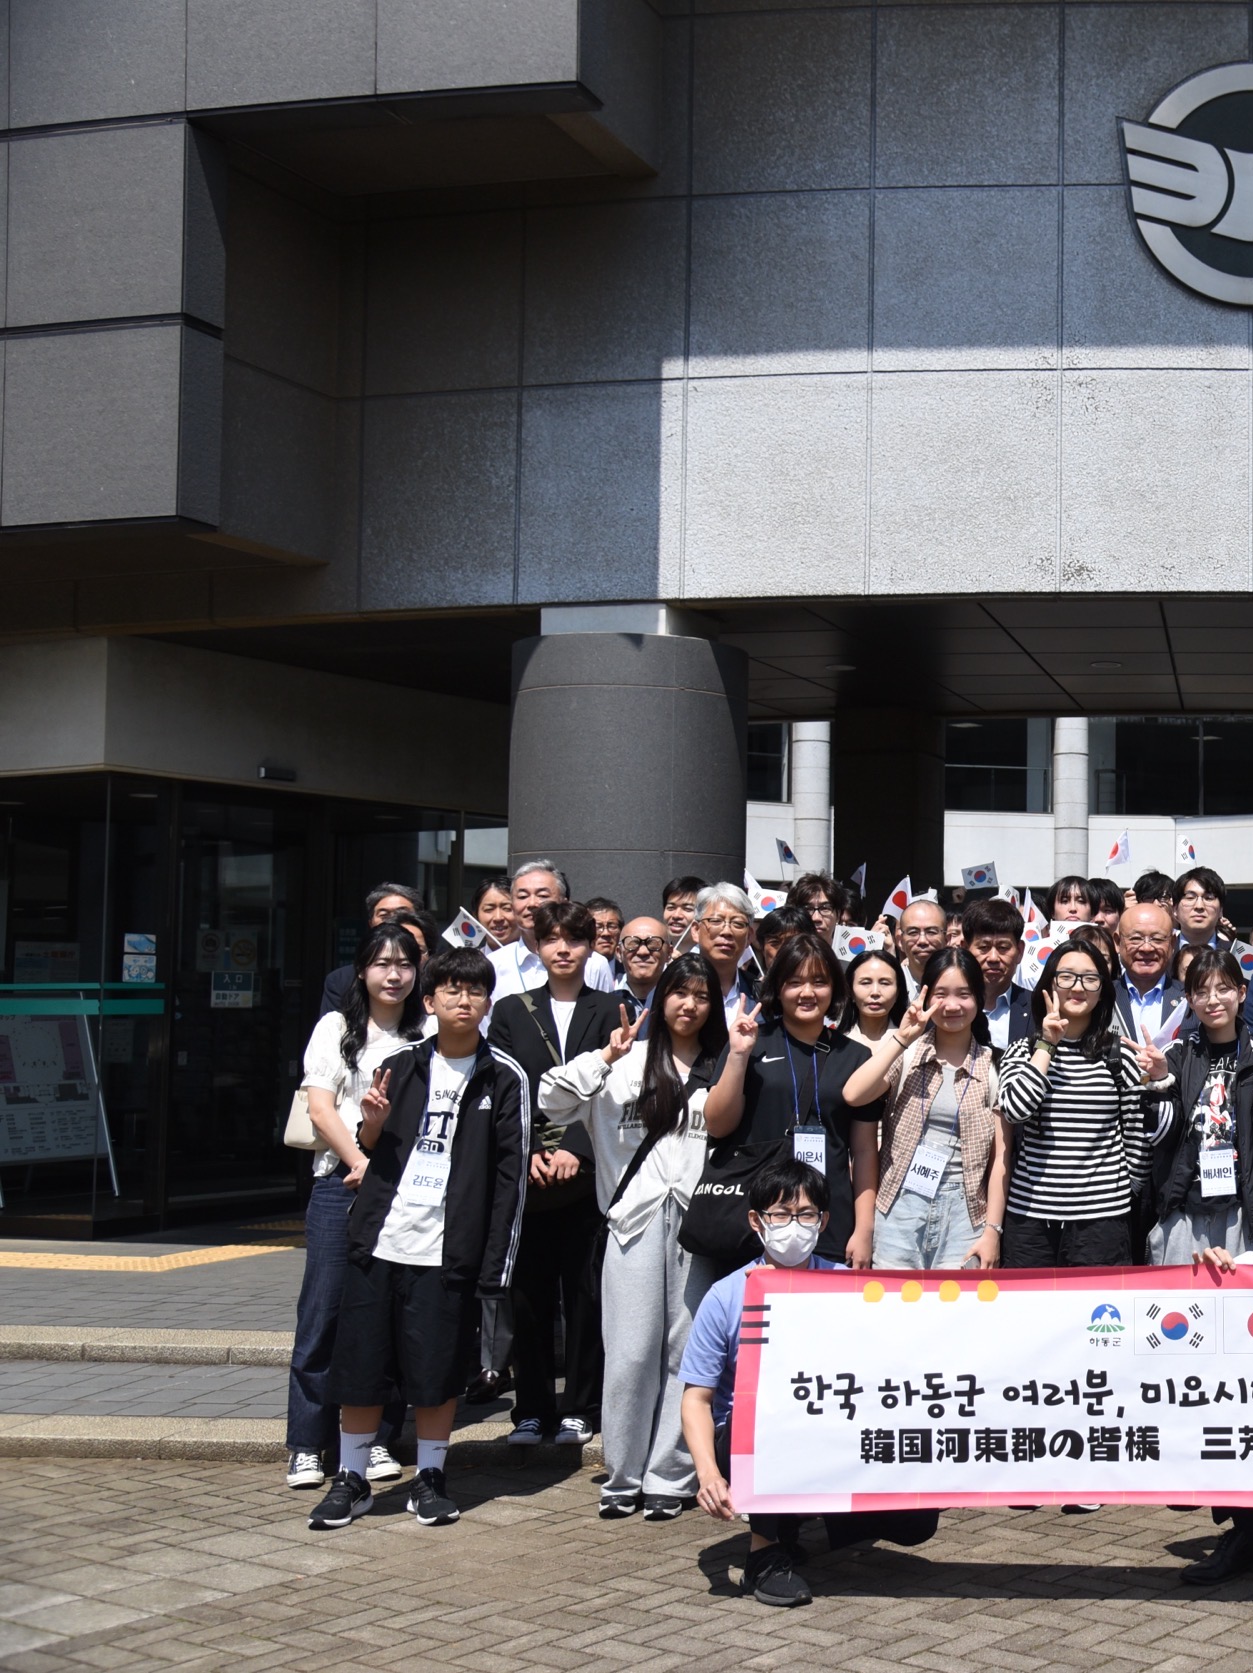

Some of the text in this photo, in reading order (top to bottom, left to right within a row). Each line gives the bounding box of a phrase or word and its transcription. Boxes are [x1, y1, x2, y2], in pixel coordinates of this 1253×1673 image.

[412, 1174, 444, 1190] 김도윤
[1089, 1337, 1121, 1347] 하동군
[790, 1371, 864, 1421] 한국
[877, 1372, 985, 1419] 하동군
[1002, 1369, 1125, 1419] 여러분,
[860, 1425, 1160, 1464] 韓国河東郡の皆様
